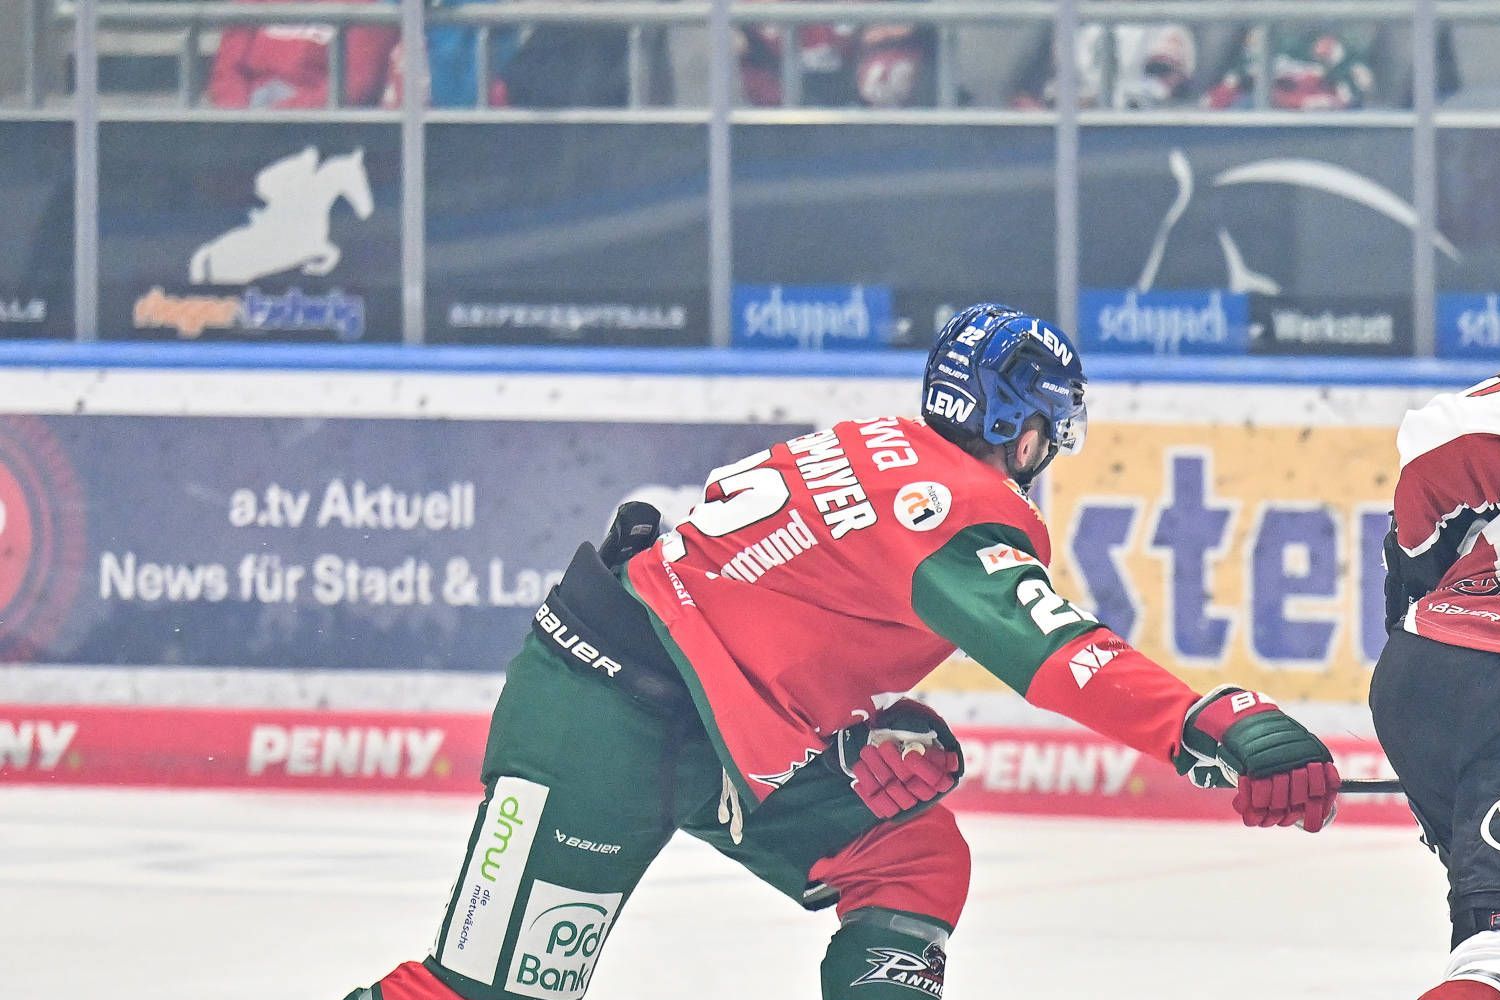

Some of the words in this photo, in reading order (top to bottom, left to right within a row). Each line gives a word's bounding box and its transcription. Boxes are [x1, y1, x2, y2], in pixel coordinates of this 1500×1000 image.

[957, 325, 986, 347] 22
[1029, 319, 1073, 367] LEW
[925, 386, 977, 423] LEW
[229, 485, 306, 529] a.tv
[316, 481, 476, 530] Aktuell
[785, 428, 879, 541] MAYER
[101, 551, 230, 604] News
[238, 553, 303, 604] für
[312, 553, 432, 606] Stadt
[444, 557, 480, 605] &
[535, 602, 622, 678] BAUER
[481, 795, 524, 884] dmw
[565, 836, 622, 855] BAUER
[457, 884, 482, 952] mietwäsche
[480, 889, 491, 907] die
[516, 953, 590, 992] Bank
